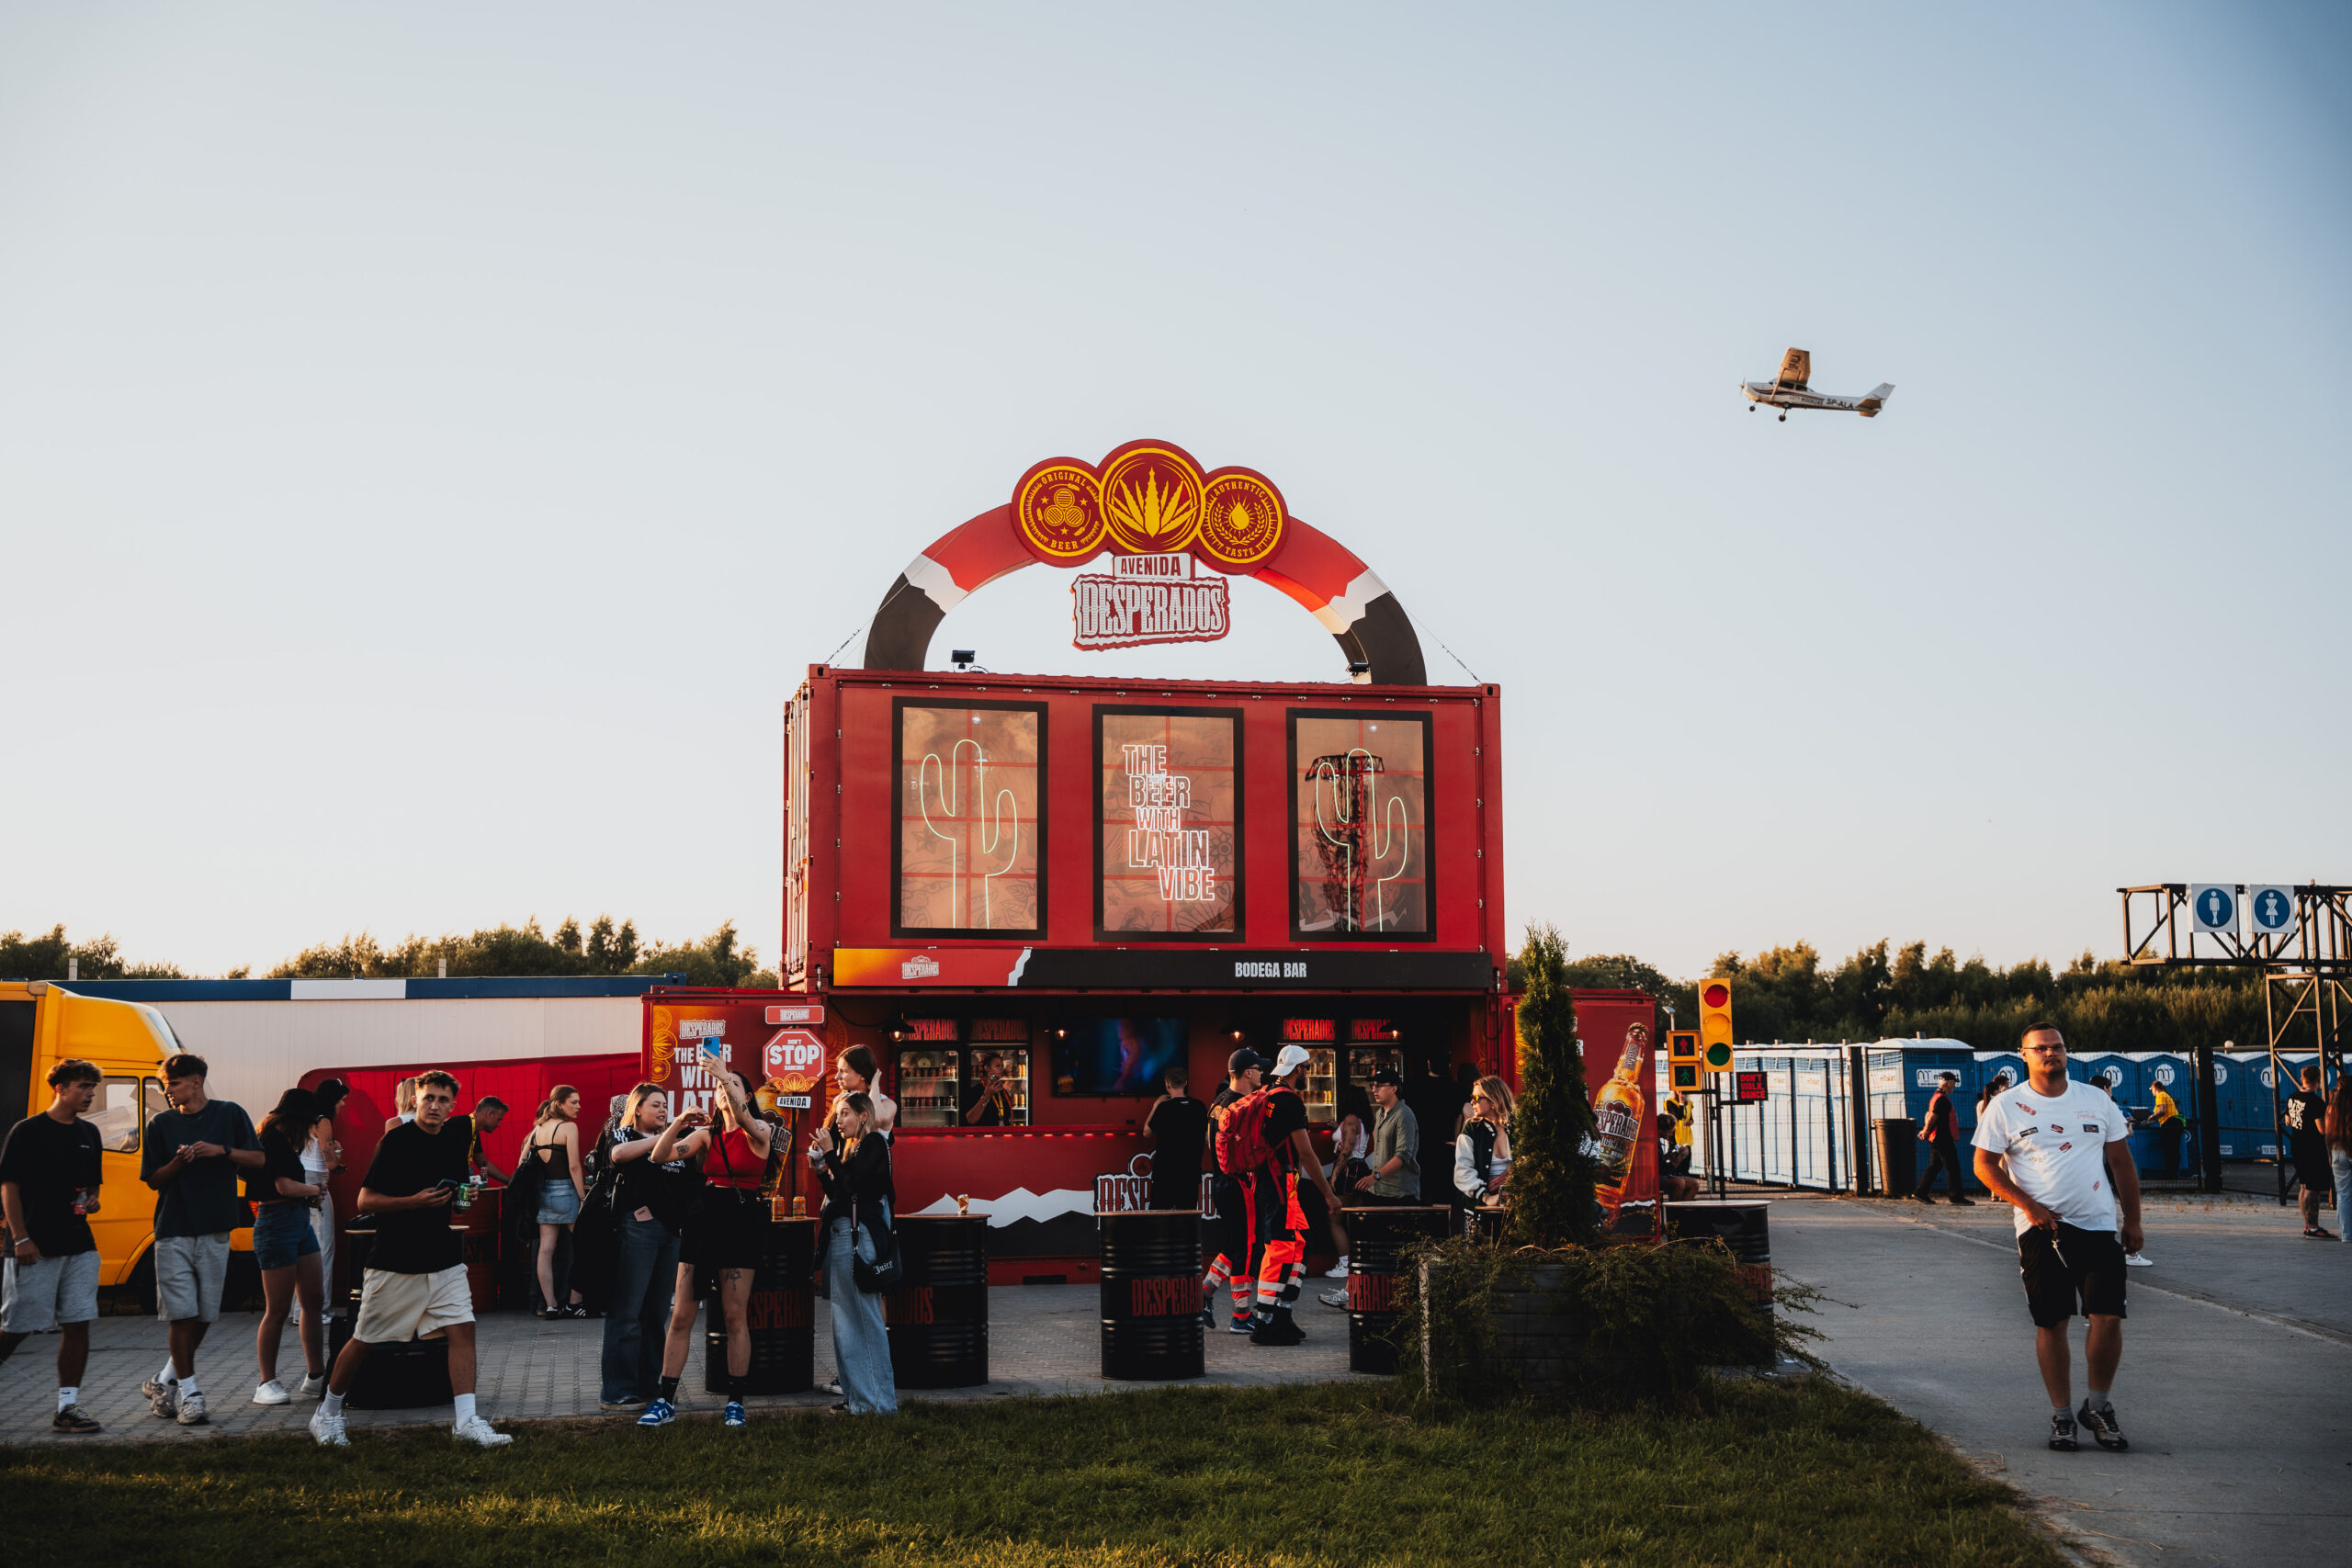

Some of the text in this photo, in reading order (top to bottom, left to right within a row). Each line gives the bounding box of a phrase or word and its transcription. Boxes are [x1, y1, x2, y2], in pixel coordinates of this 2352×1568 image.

[1041, 471, 1086, 486] ORIGINAL
[1213, 481, 1265, 498] AUTHENTIC
[1050, 540, 1079, 550] BEER
[1225, 547, 1255, 558] TASTE
[1120, 556, 1182, 576] AVENIDA
[1081, 581, 1222, 636] DESPERADOS
[1122, 744, 1167, 776] THE
[1129, 775, 1191, 808] BEER
[1136, 807, 1182, 831] WITH
[1129, 829, 1209, 868] LATIN
[1158, 867, 1216, 901] VIBE
[1235, 962, 1307, 977] BODEGA BAR
[681, 1021, 725, 1038] DESPERADOS
[1283, 1019, 1336, 1041] DESPERADOS
[673, 1043, 732, 1063] THE BR
[769, 1044, 820, 1066] STOP
[1740, 1074, 1762, 1082] DON'T
[779, 1097, 807, 1107] AVENIDA
[1741, 1090, 1766, 1100] DANCE
[667, 1090, 717, 1123] LAT
